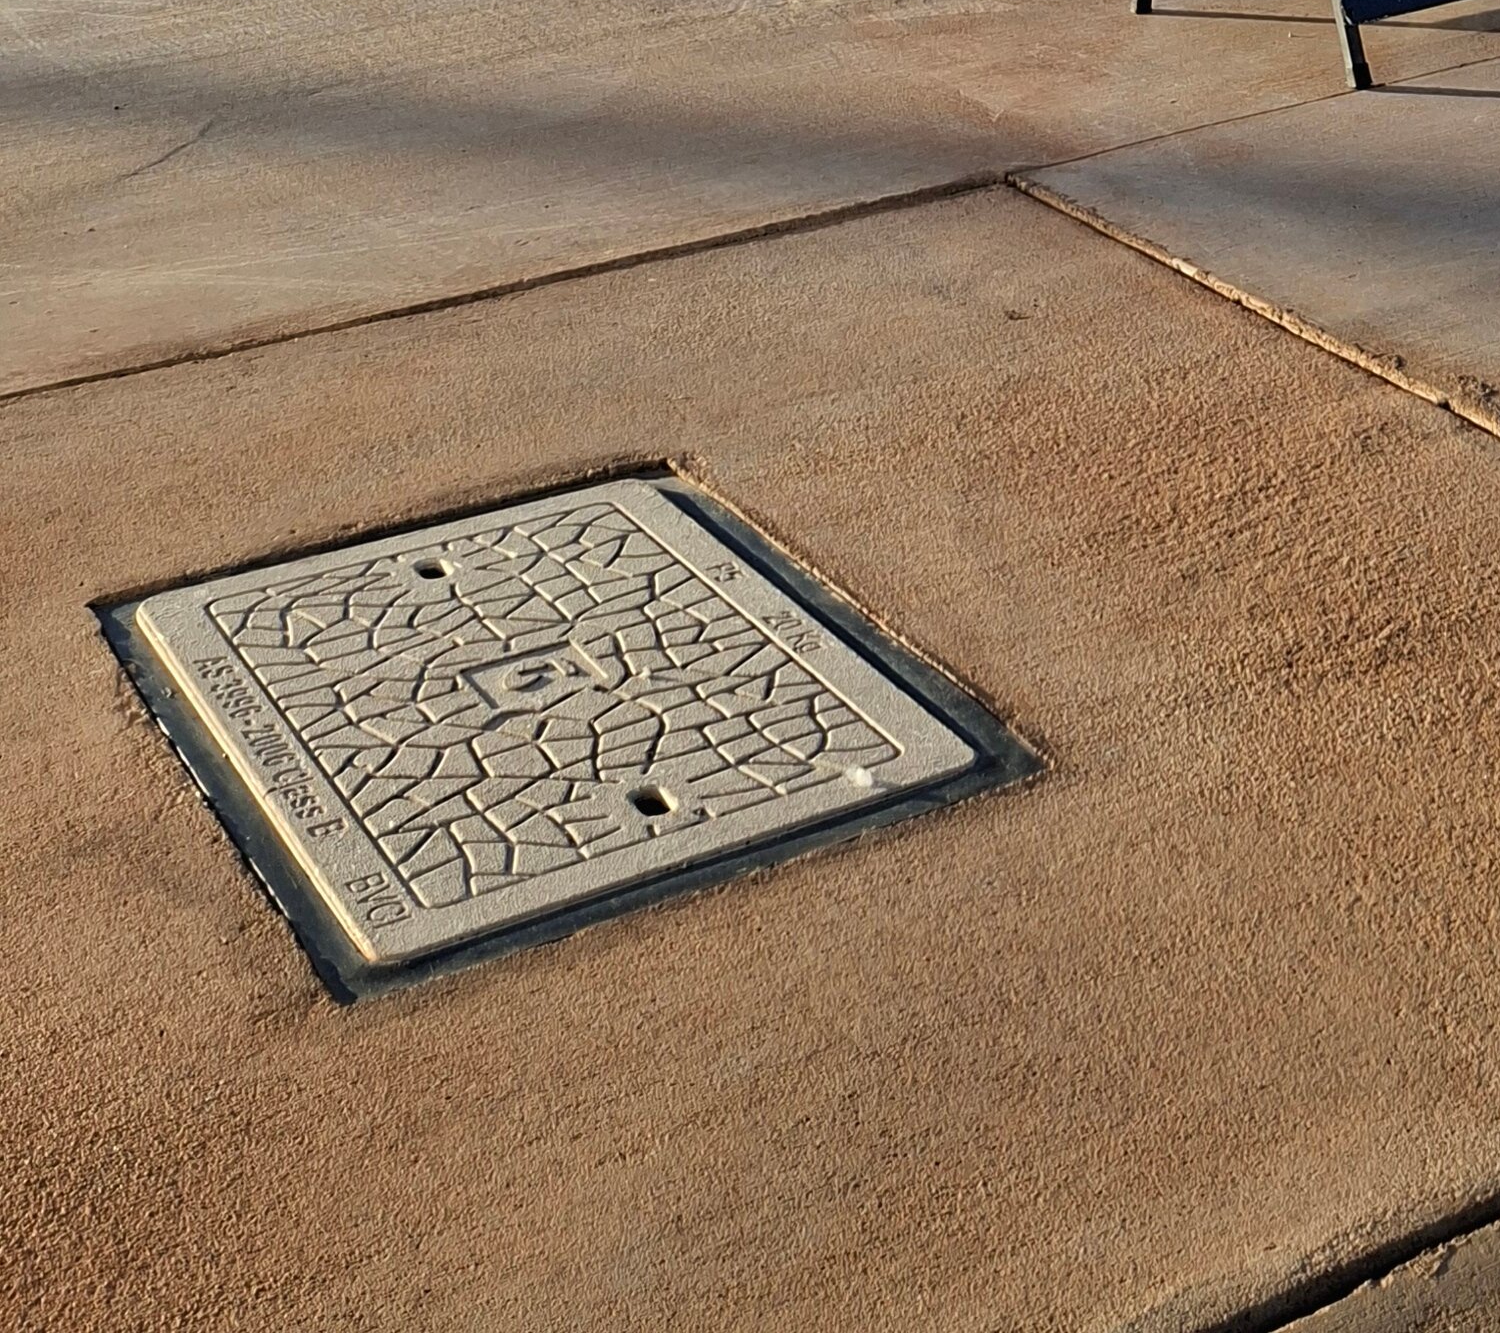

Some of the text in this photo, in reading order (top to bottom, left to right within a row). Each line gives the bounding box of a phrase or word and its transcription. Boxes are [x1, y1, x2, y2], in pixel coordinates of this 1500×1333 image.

[192, 656, 233, 680] AS
[272, 766, 325, 820] Class
[306, 816, 349, 838] B
